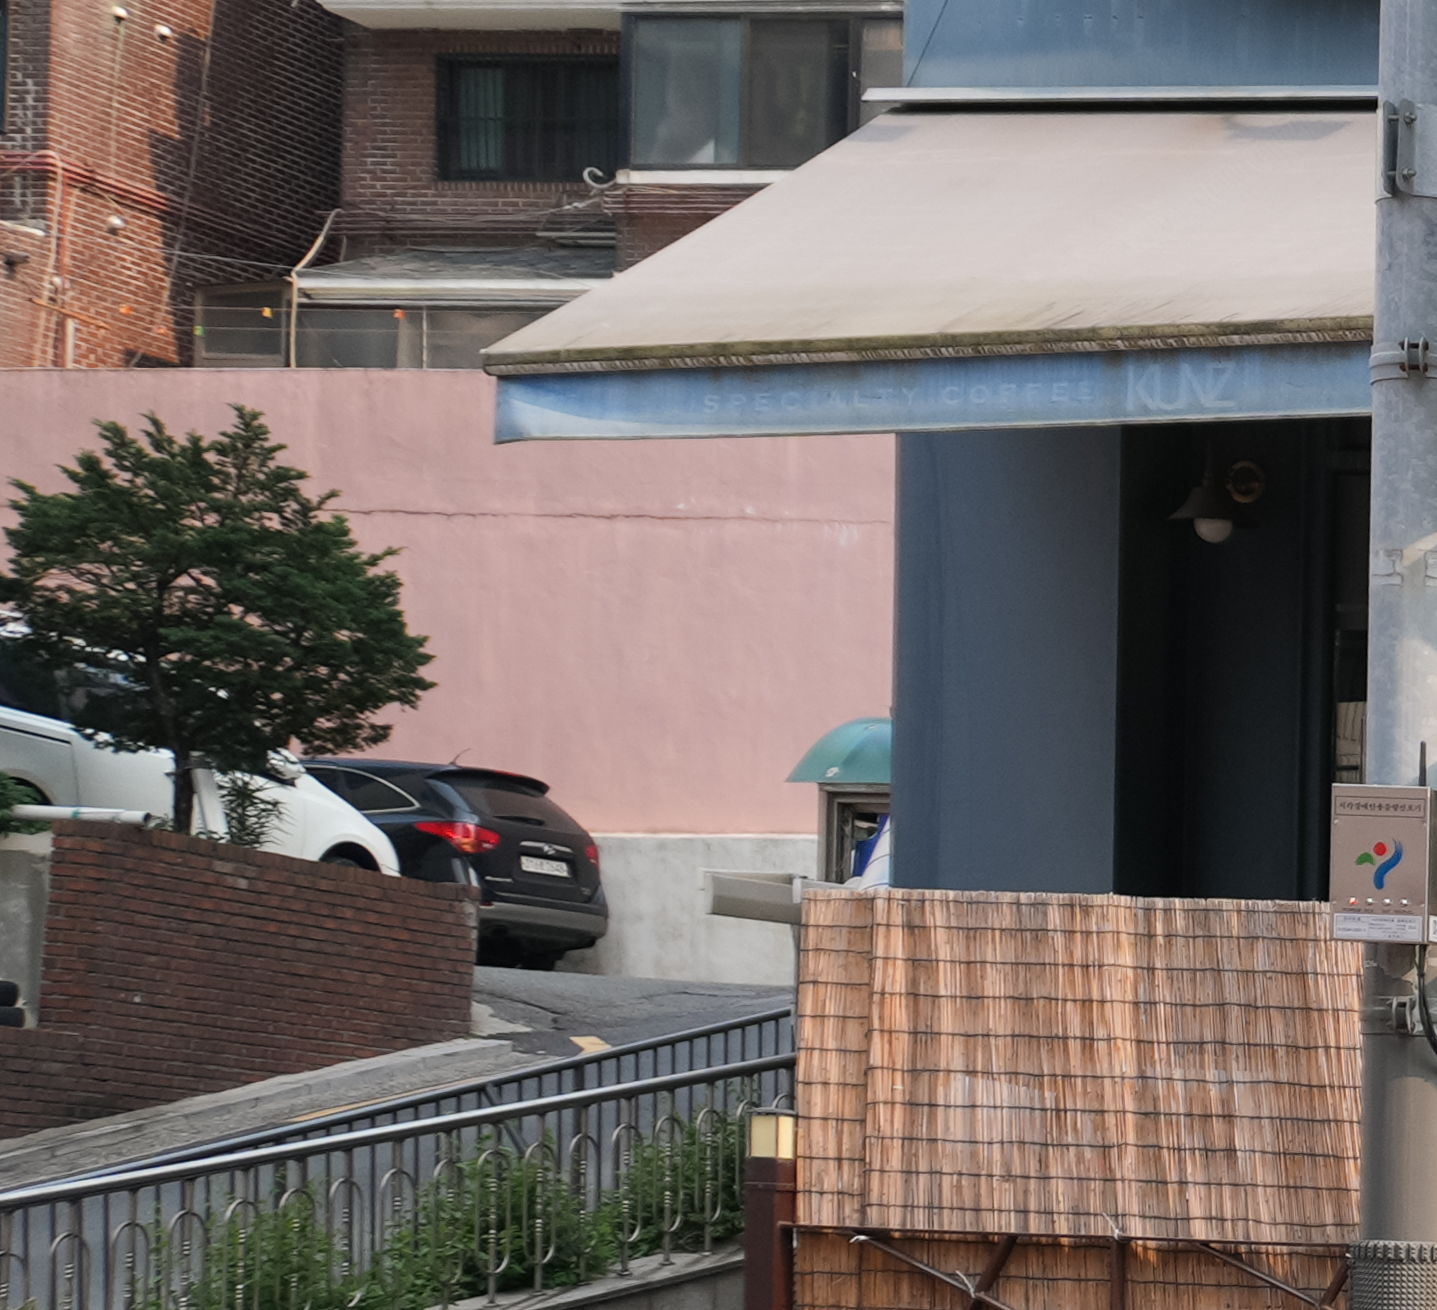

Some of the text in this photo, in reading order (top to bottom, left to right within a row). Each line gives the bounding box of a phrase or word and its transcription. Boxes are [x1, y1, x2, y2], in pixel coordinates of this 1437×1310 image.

[702, 360, 1236, 415] SPECIALTY COFFEE KUNZ
